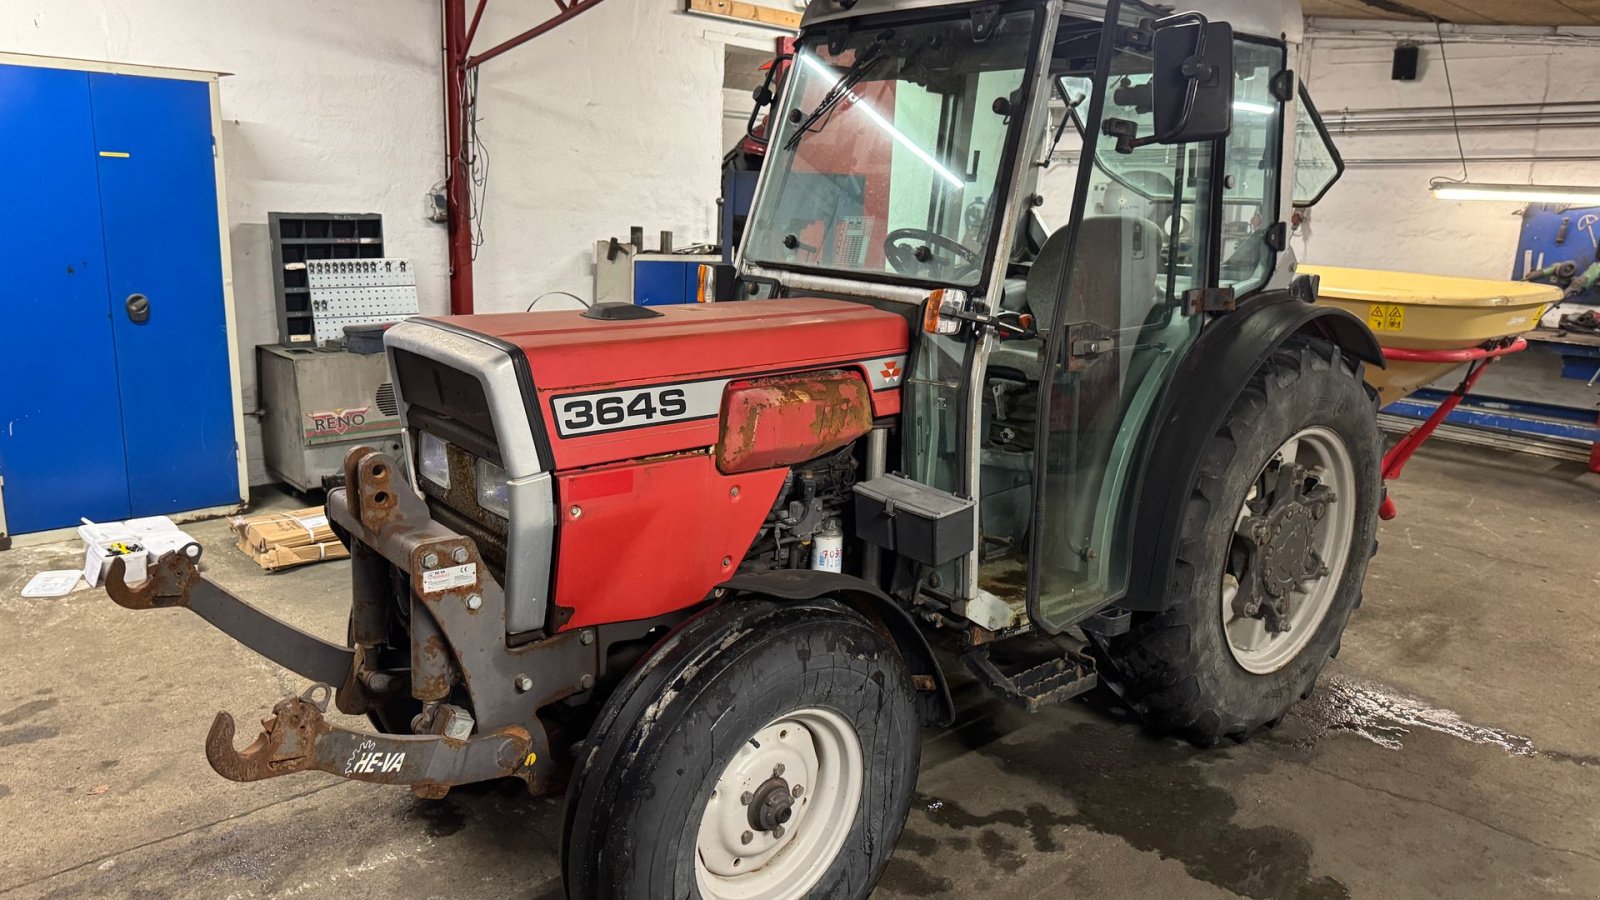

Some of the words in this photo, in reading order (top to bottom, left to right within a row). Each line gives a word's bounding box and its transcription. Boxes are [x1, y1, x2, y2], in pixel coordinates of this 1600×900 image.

[563, 388, 687, 430] 364S
[314, 414, 366, 431] RENO
[353, 752, 406, 773] HE-VA
